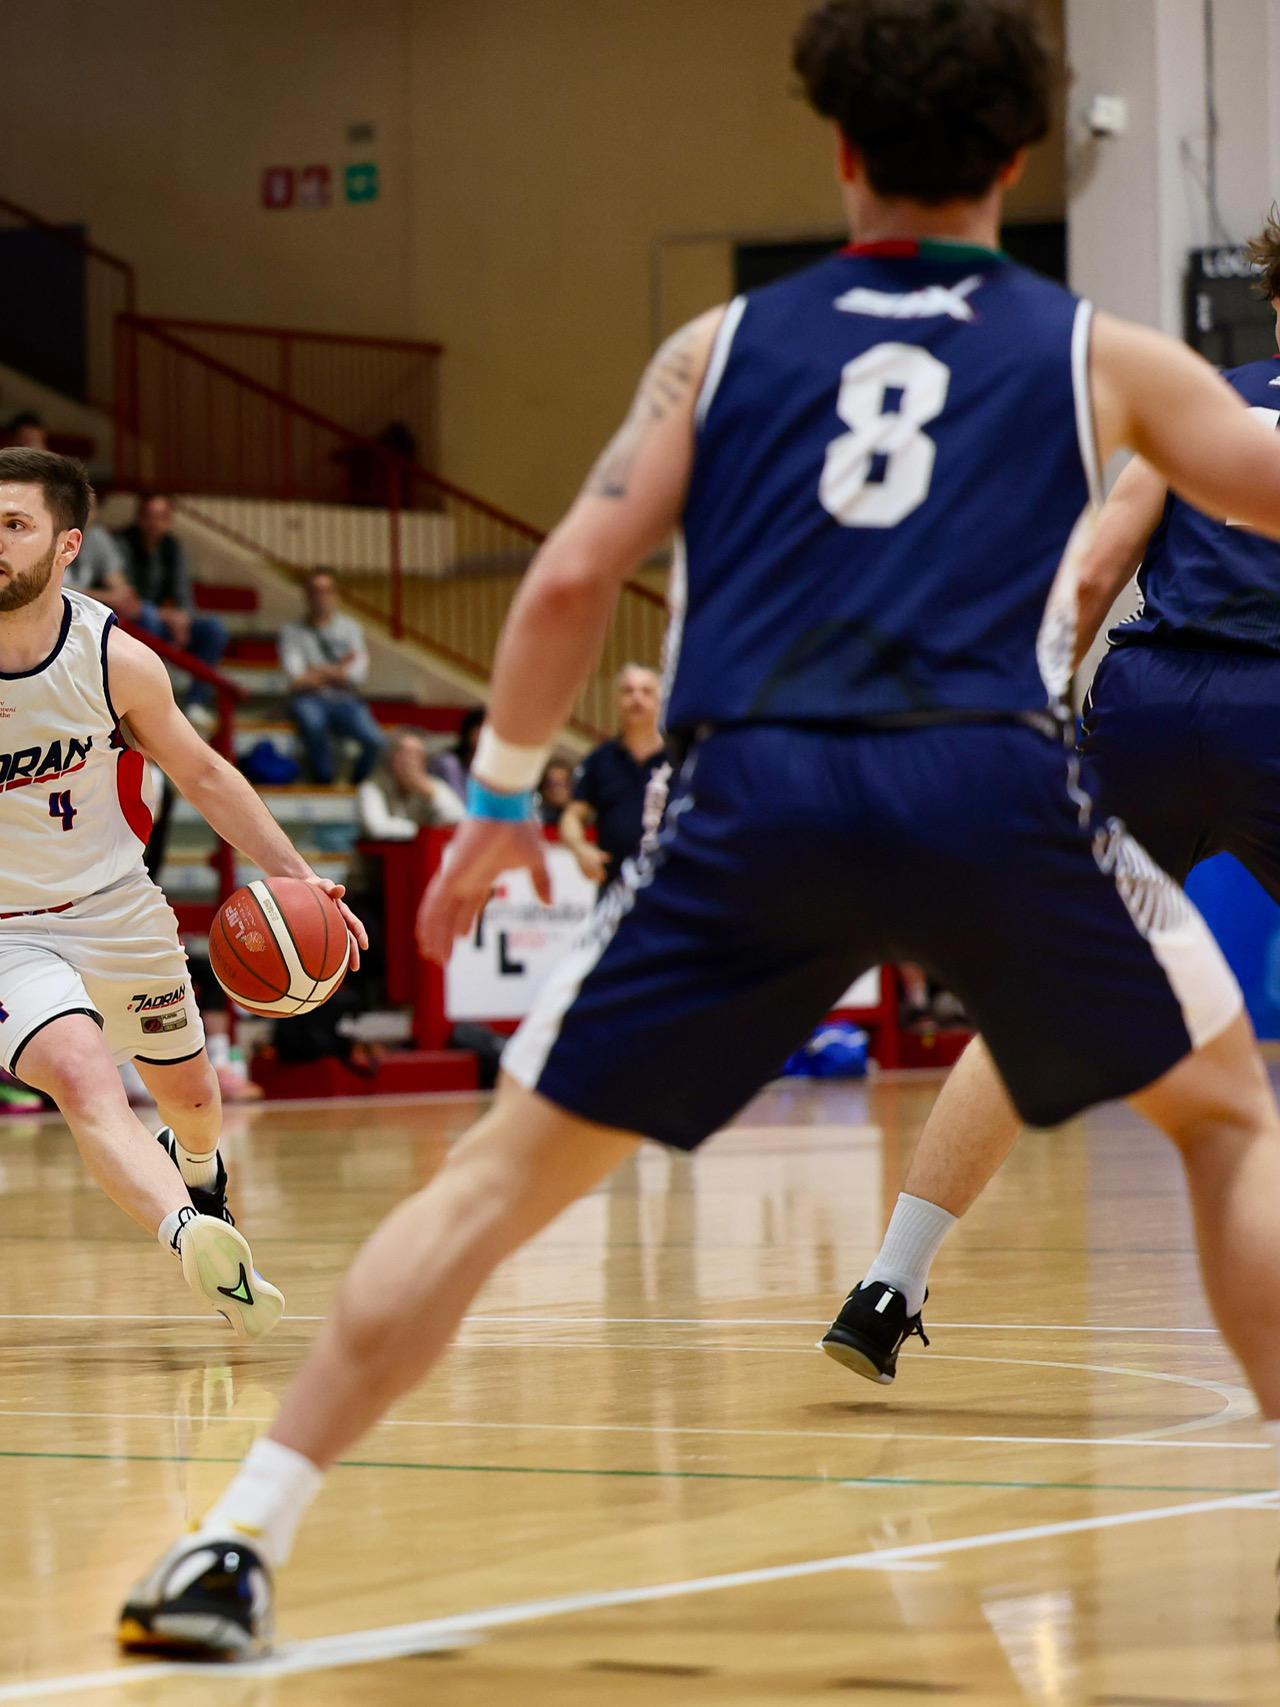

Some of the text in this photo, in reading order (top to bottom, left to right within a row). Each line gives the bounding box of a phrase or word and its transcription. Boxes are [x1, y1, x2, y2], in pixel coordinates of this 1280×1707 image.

[819, 341, 950, 528] 8
[49, 789, 77, 832] 4
[132, 983, 186, 1013] JADRAN
